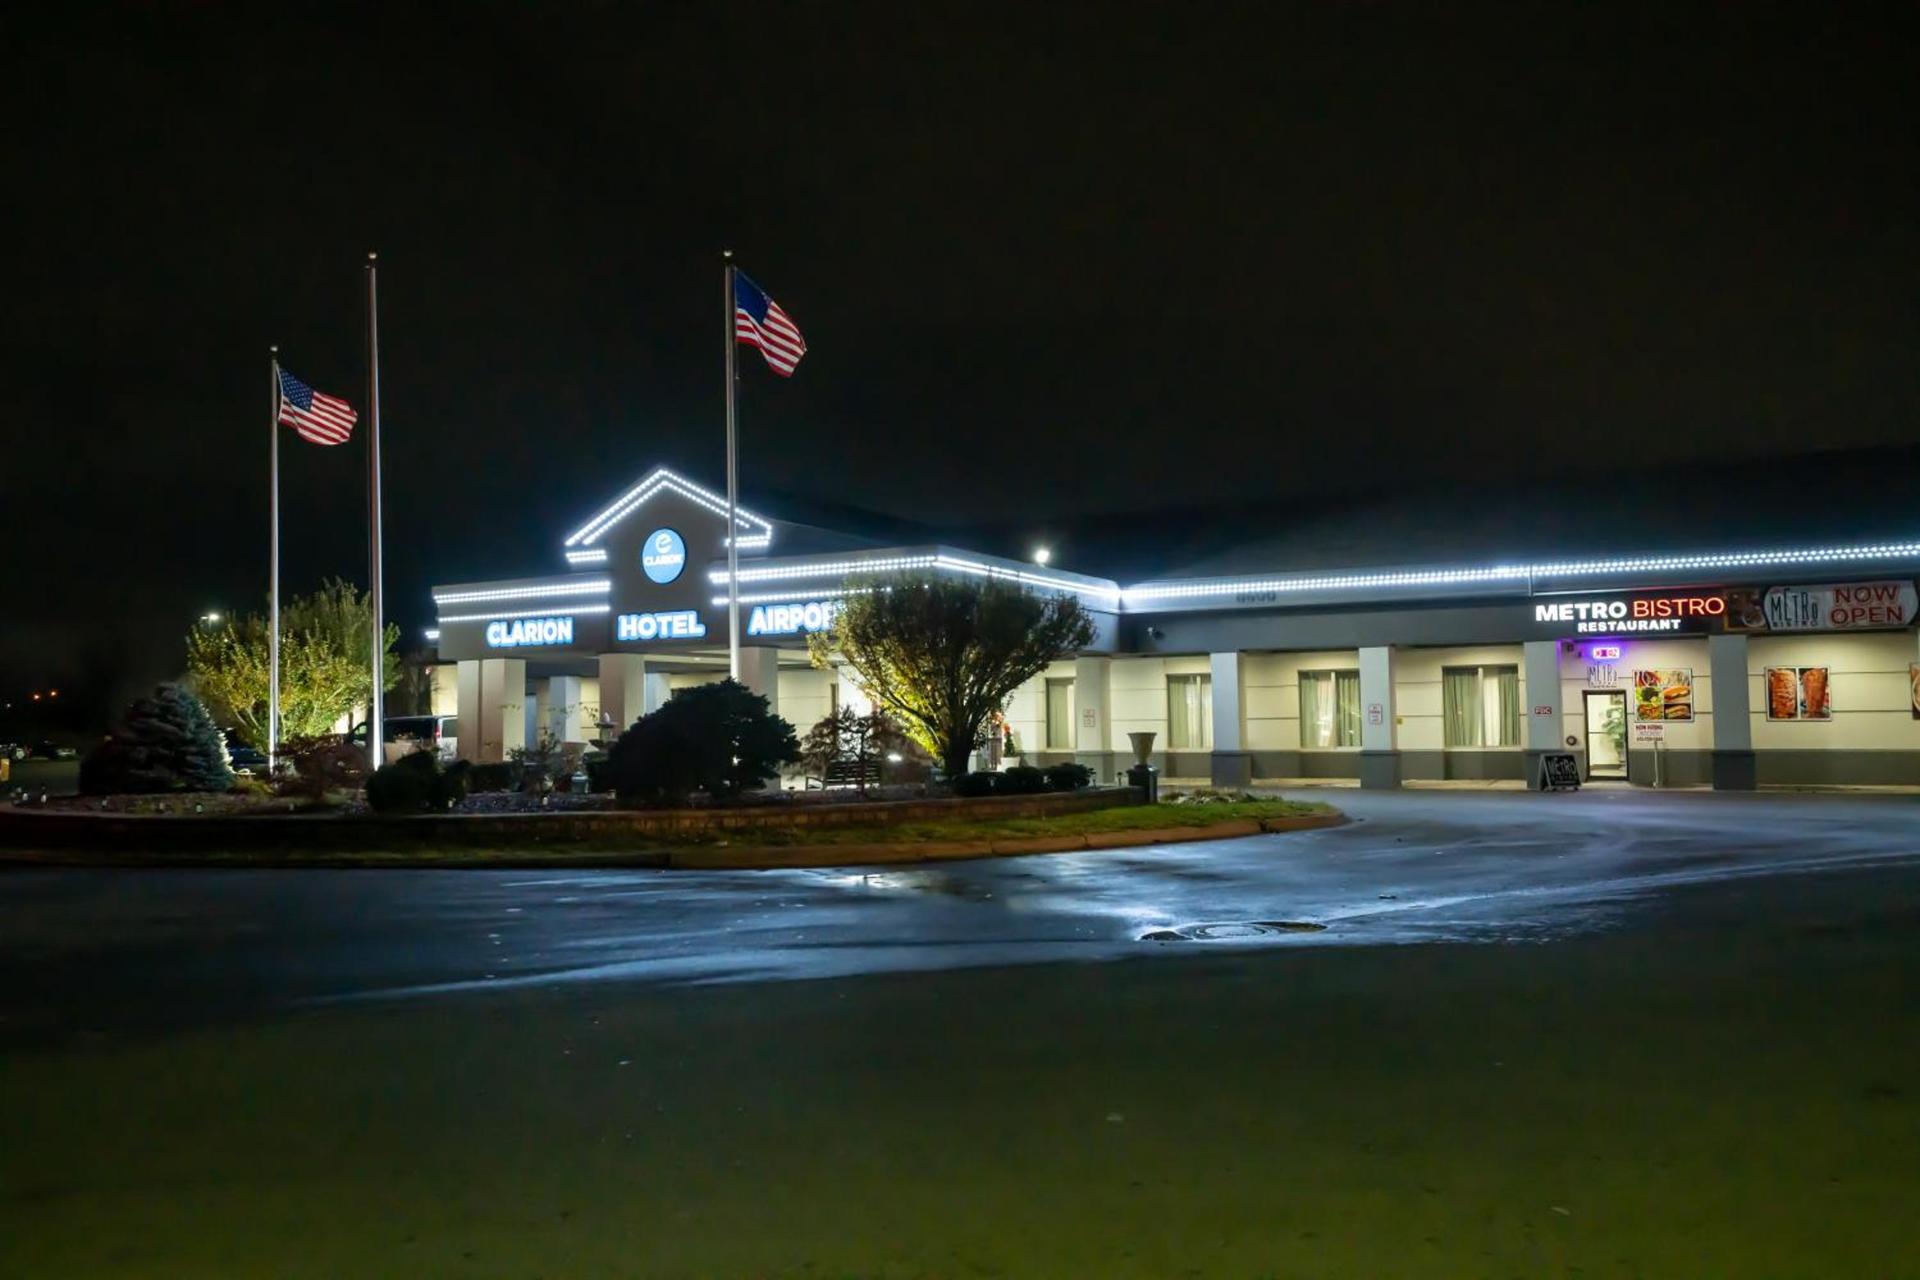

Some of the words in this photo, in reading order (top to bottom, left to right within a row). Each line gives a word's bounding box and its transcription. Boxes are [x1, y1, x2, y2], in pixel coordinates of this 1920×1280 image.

[1834, 585, 1898, 603] NOW
[747, 601, 846, 635] AIRPOR
[1535, 601, 1627, 621] METRO
[1633, 596, 1725, 617] BISTRO
[1831, 605, 1903, 624] OPEN
[486, 617, 574, 647] CLARION
[618, 610, 705, 640] HOTEL
[1577, 619, 1681, 633] RESTAURANT
